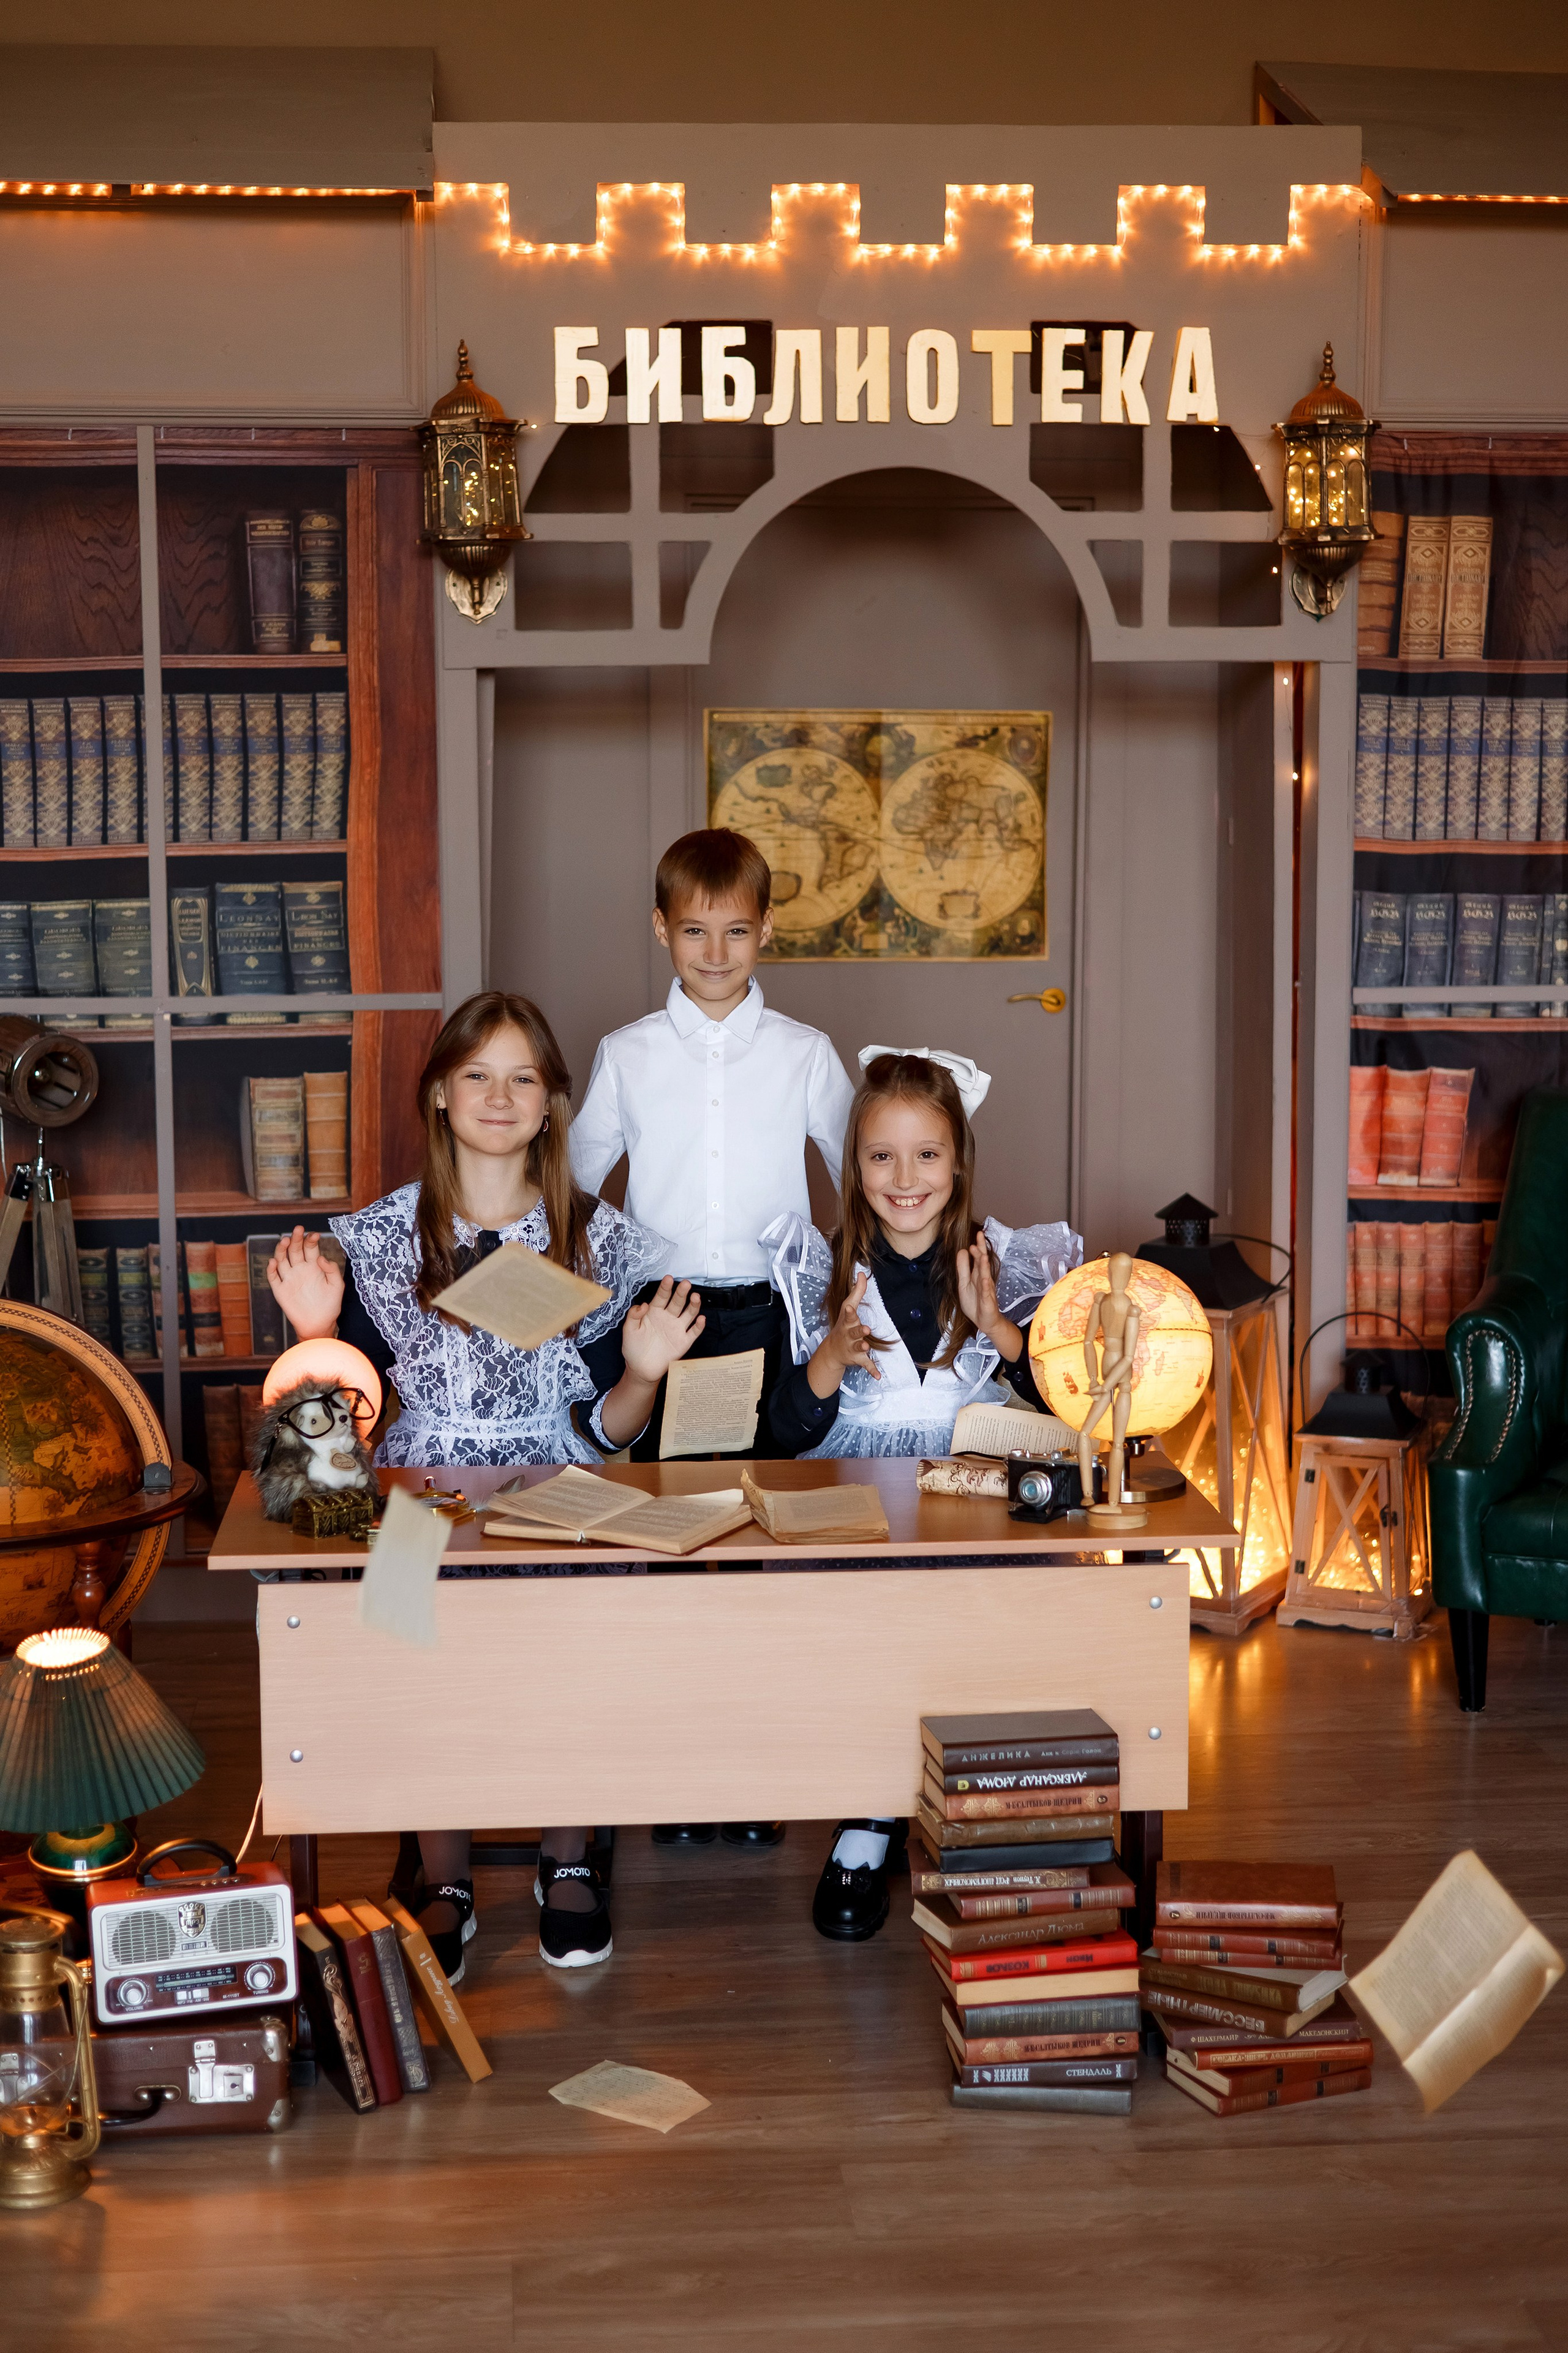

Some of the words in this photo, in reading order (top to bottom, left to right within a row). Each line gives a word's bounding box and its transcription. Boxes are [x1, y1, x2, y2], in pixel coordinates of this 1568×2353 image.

[553, 326, 1219, 426] БИБЛИОТЕКА
[961, 1750, 1031, 1762] АНЖЕЛИКА
[976, 1775, 1017, 1789] ДЮМА
[1019, 1770, 1088, 1787] АЛЕКСАНДР
[553, 1867, 591, 1879] JOMOTO
[978, 1928, 1044, 1946] Александр
[1047, 1922, 1085, 1935] Дюма
[1147, 1990, 1265, 2033] БЕССМЕРТНЫЕ
[1066, 2068, 1112, 2077] СТЕНДАЛЬ
